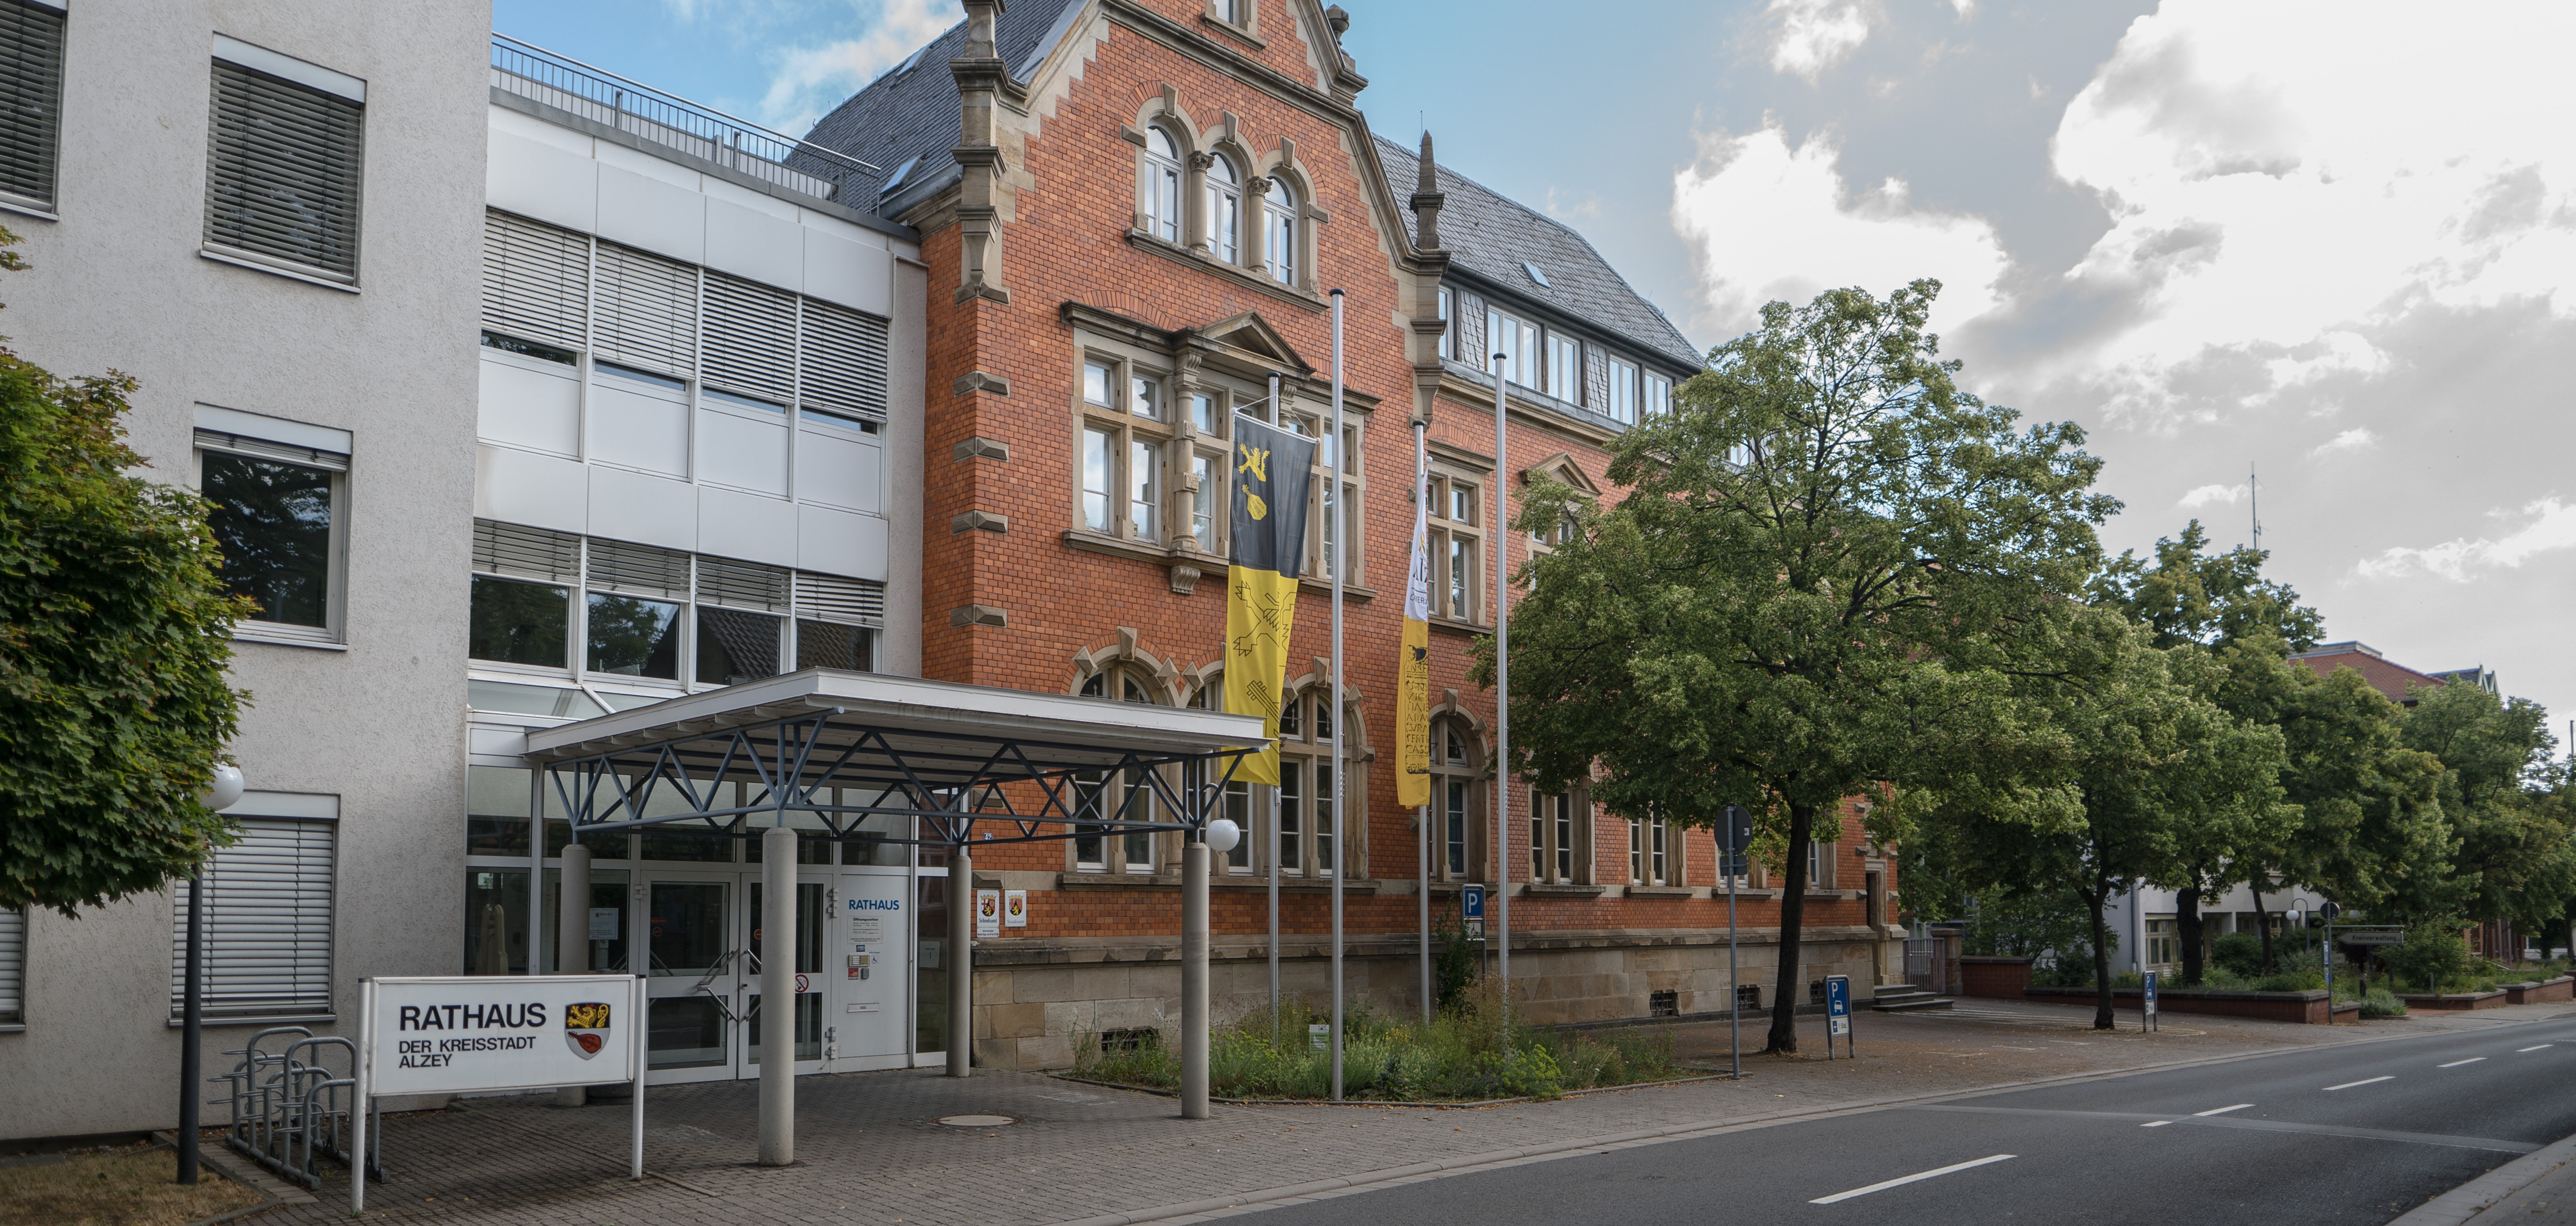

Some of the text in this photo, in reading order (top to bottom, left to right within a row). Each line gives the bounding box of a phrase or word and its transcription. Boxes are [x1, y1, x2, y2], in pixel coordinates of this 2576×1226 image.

[849, 899, 899, 910] RATHAUS
[1469, 893, 1477, 913] P
[2146, 976, 2150, 987] P
[1832, 982, 1838, 997] P
[400, 1003, 546, 1031] RATHAUS
[399, 1036, 536, 1053] DER KREISSTADT
[399, 1053, 452, 1068] ALZEY
